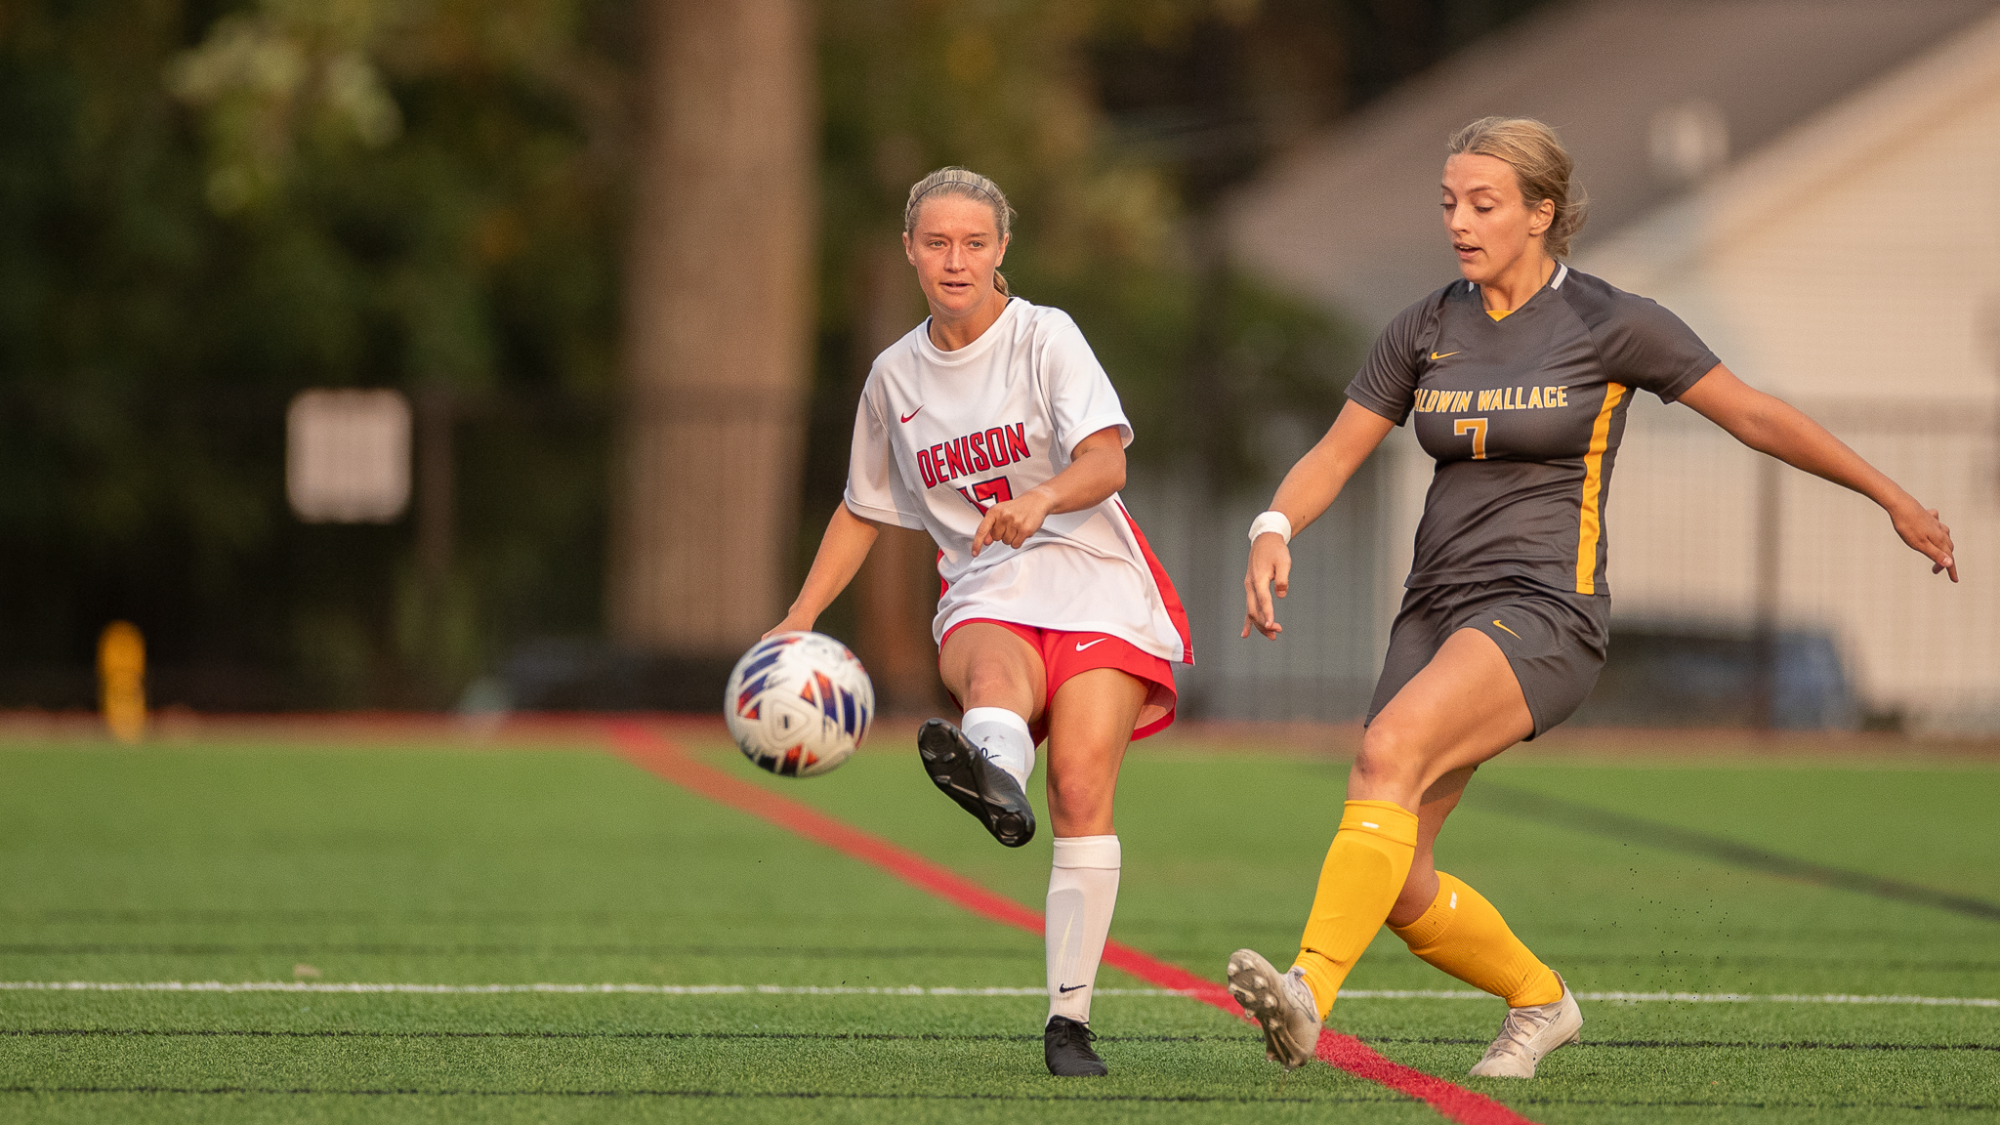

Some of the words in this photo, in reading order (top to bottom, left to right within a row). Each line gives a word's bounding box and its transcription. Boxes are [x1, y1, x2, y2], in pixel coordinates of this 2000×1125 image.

[1414, 388, 1474, 413] ALDWIN
[1477, 385, 1569, 412] WALLACE
[916, 421, 1031, 489] DENISON
[1453, 417, 1489, 460] 7
